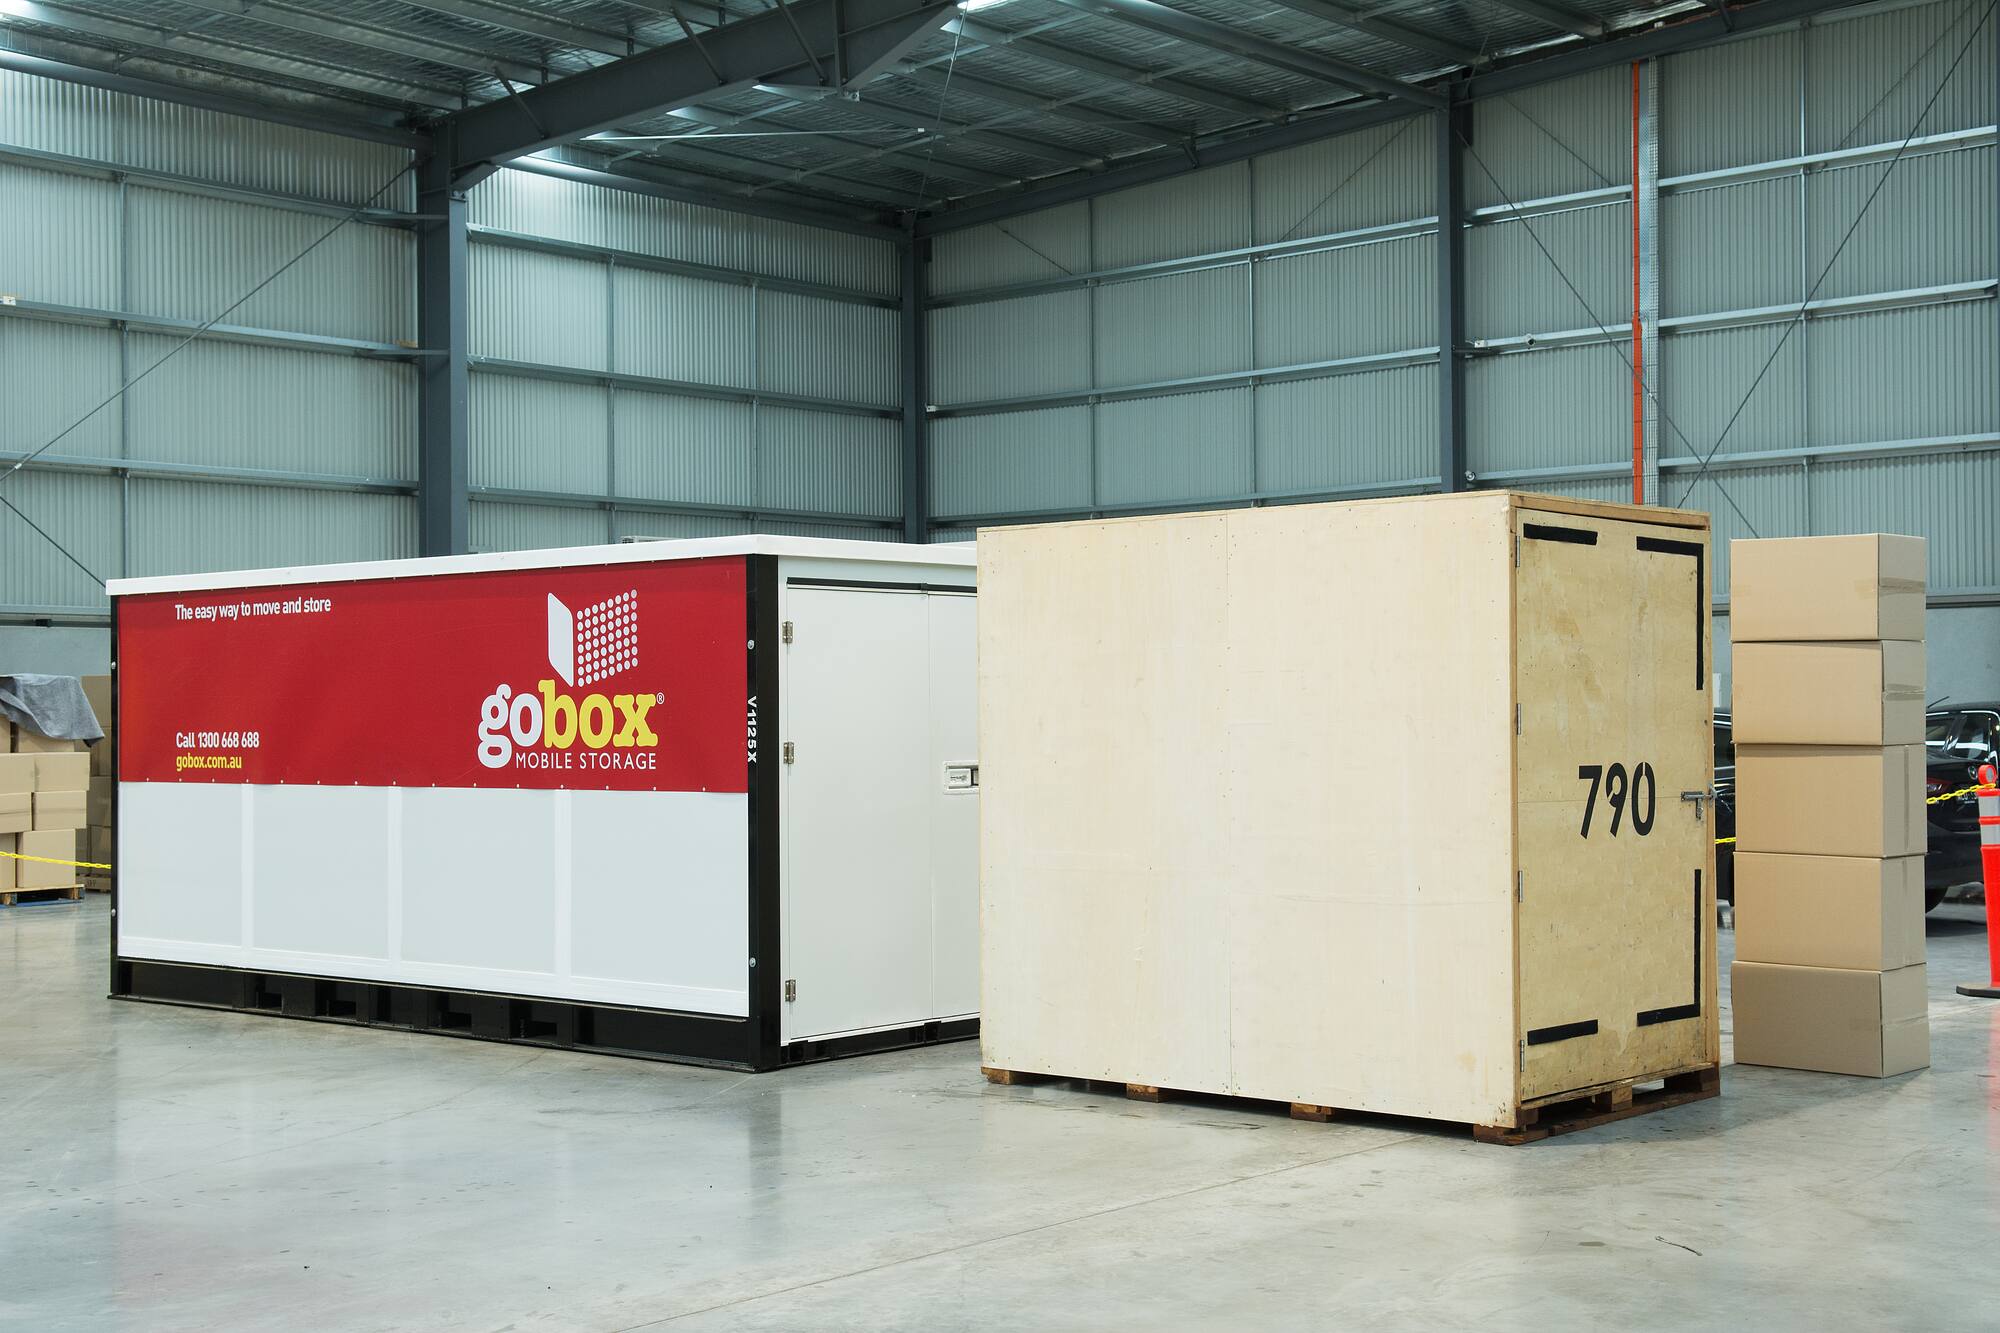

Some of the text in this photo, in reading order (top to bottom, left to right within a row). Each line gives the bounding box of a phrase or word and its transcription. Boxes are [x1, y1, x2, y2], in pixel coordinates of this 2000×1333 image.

[175, 596, 331, 622] The easy way to move and store
[176, 731, 259, 748] Call 1300 668 688
[747, 695, 757, 764] V1125X
[176, 752, 242, 772] gobox.com.au
[516, 752, 656, 770] MOBILE STORAGE
[1578, 761, 1656, 840] 790
